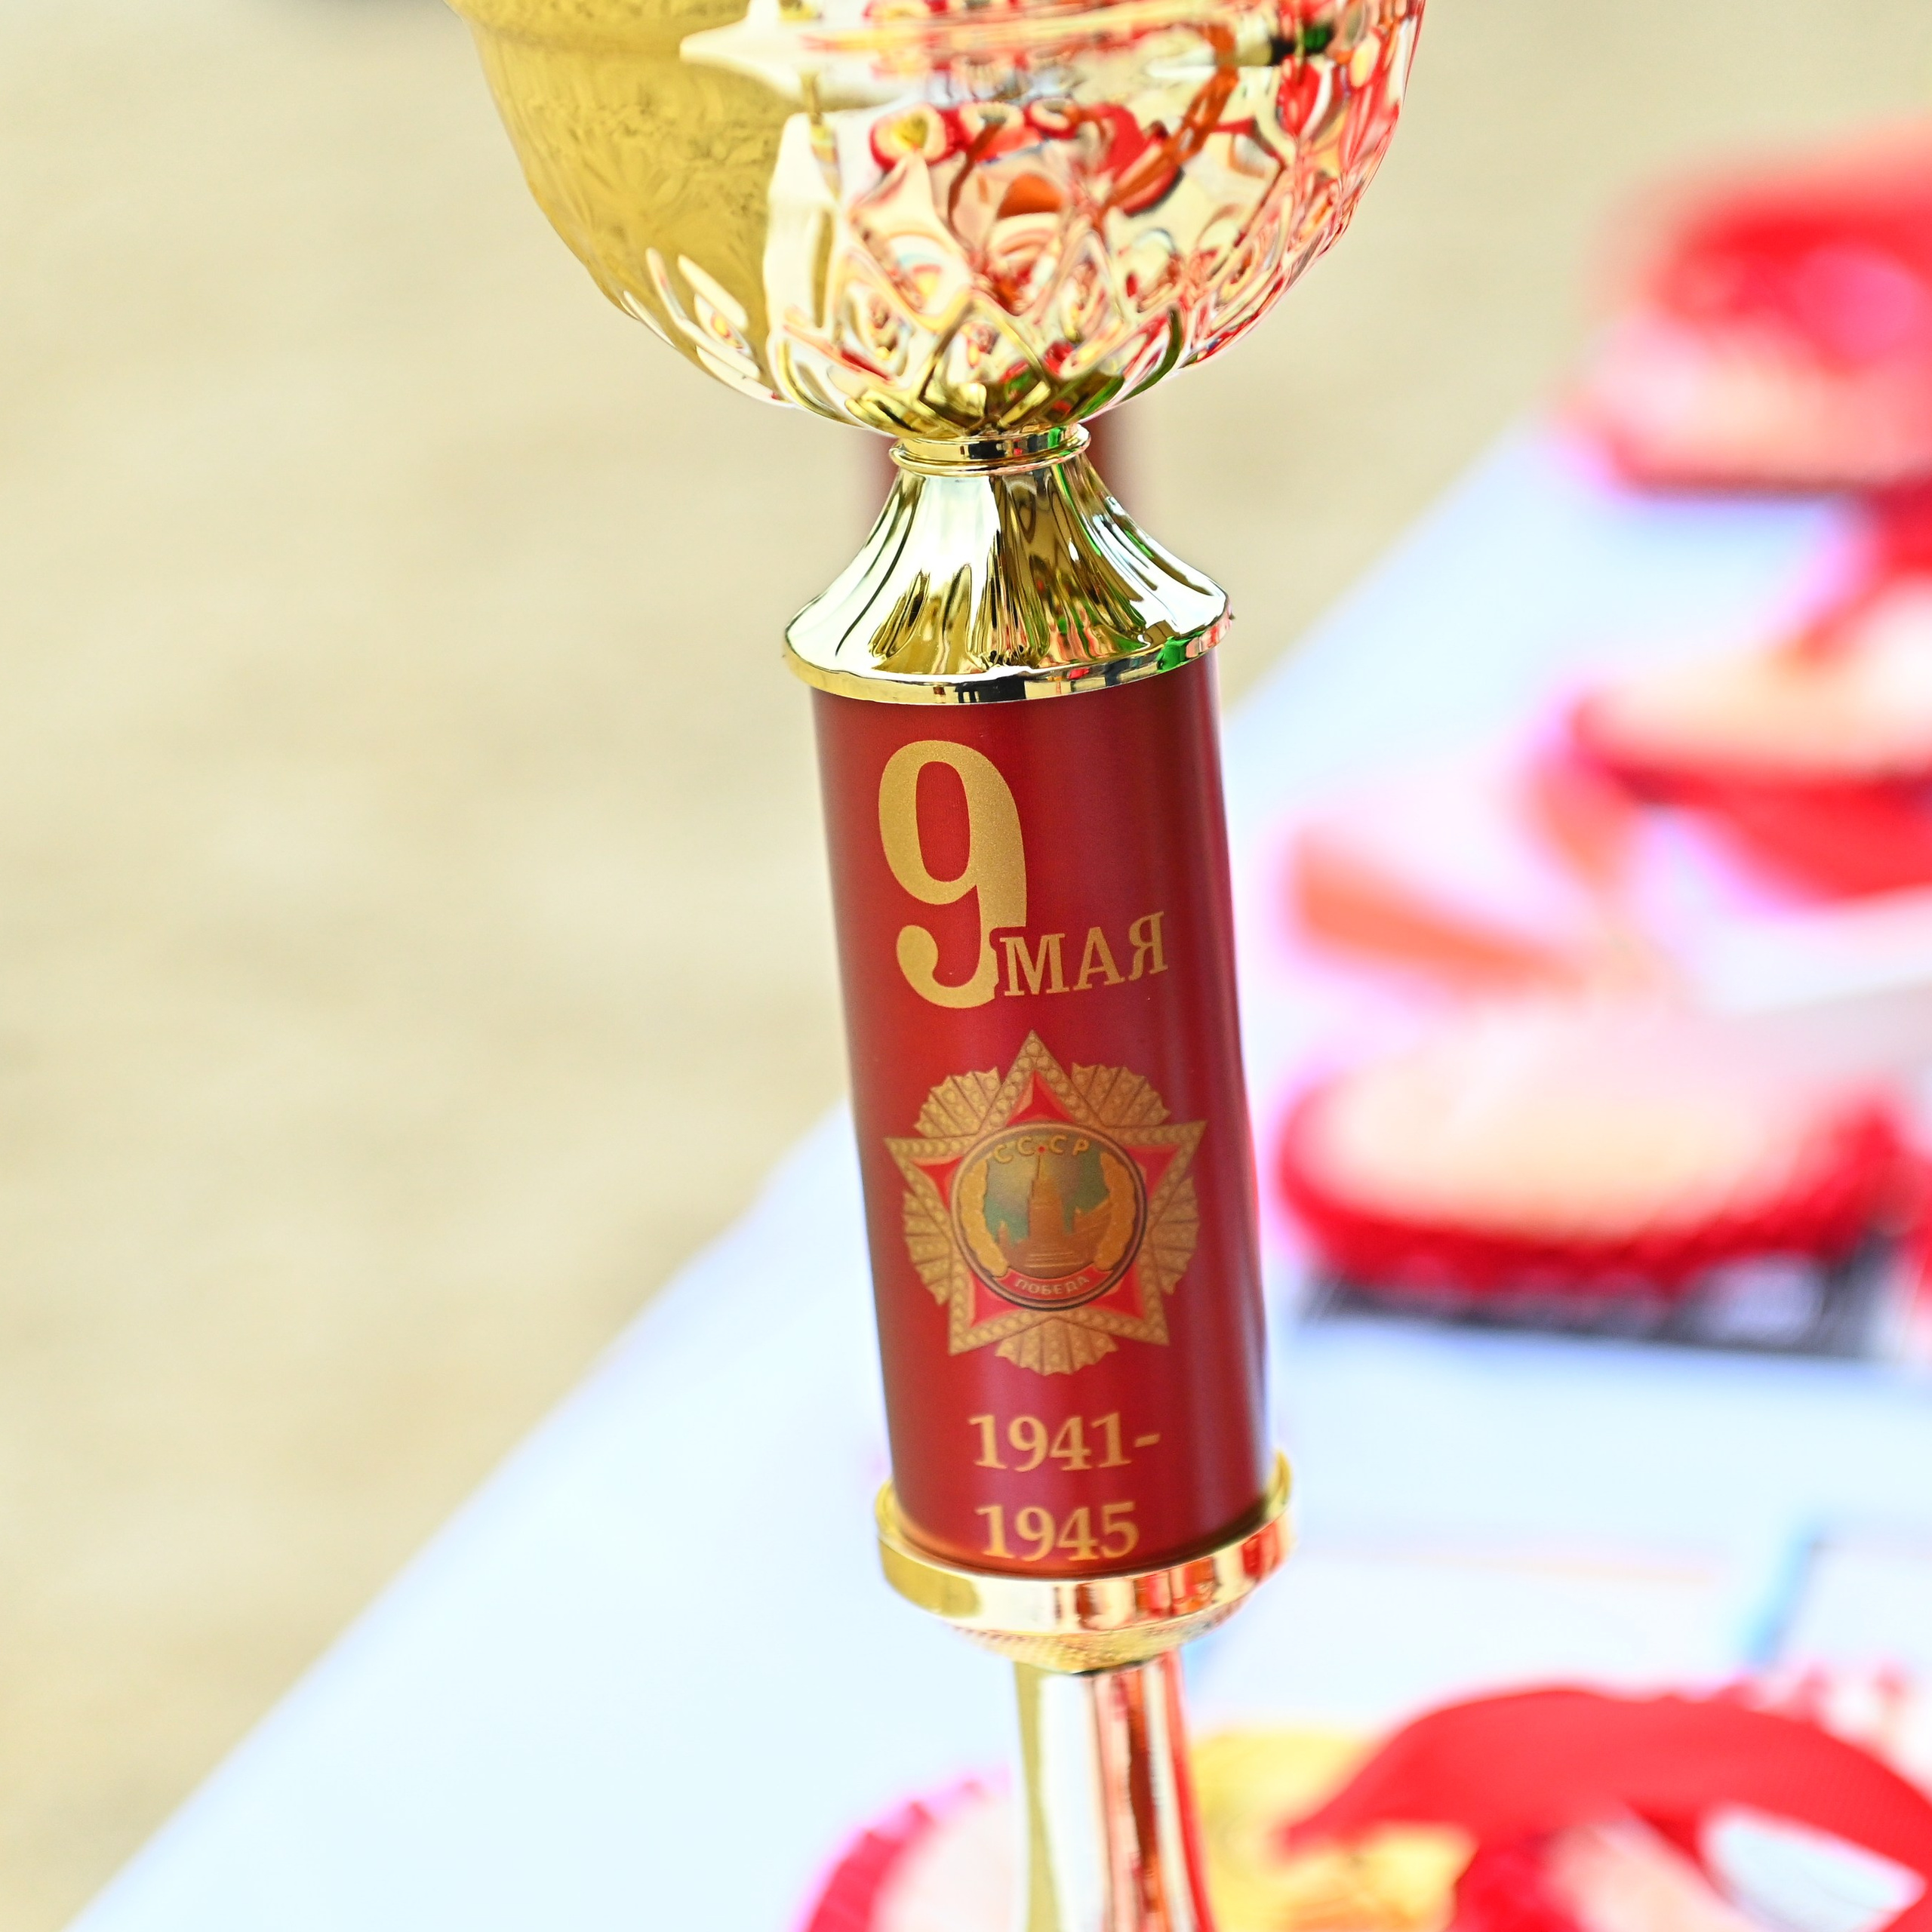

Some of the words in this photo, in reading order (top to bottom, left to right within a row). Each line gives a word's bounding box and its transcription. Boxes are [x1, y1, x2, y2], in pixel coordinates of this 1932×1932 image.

[878, 740, 1027, 1009] 9
[999, 911, 1168, 996] МАЯ
[993, 1134, 1090, 1164] СССР
[1014, 1275, 1091, 1296] ПОБЕДА
[968, 1412, 1161, 1472] 1941-
[974, 1501, 1140, 1562] 1945
